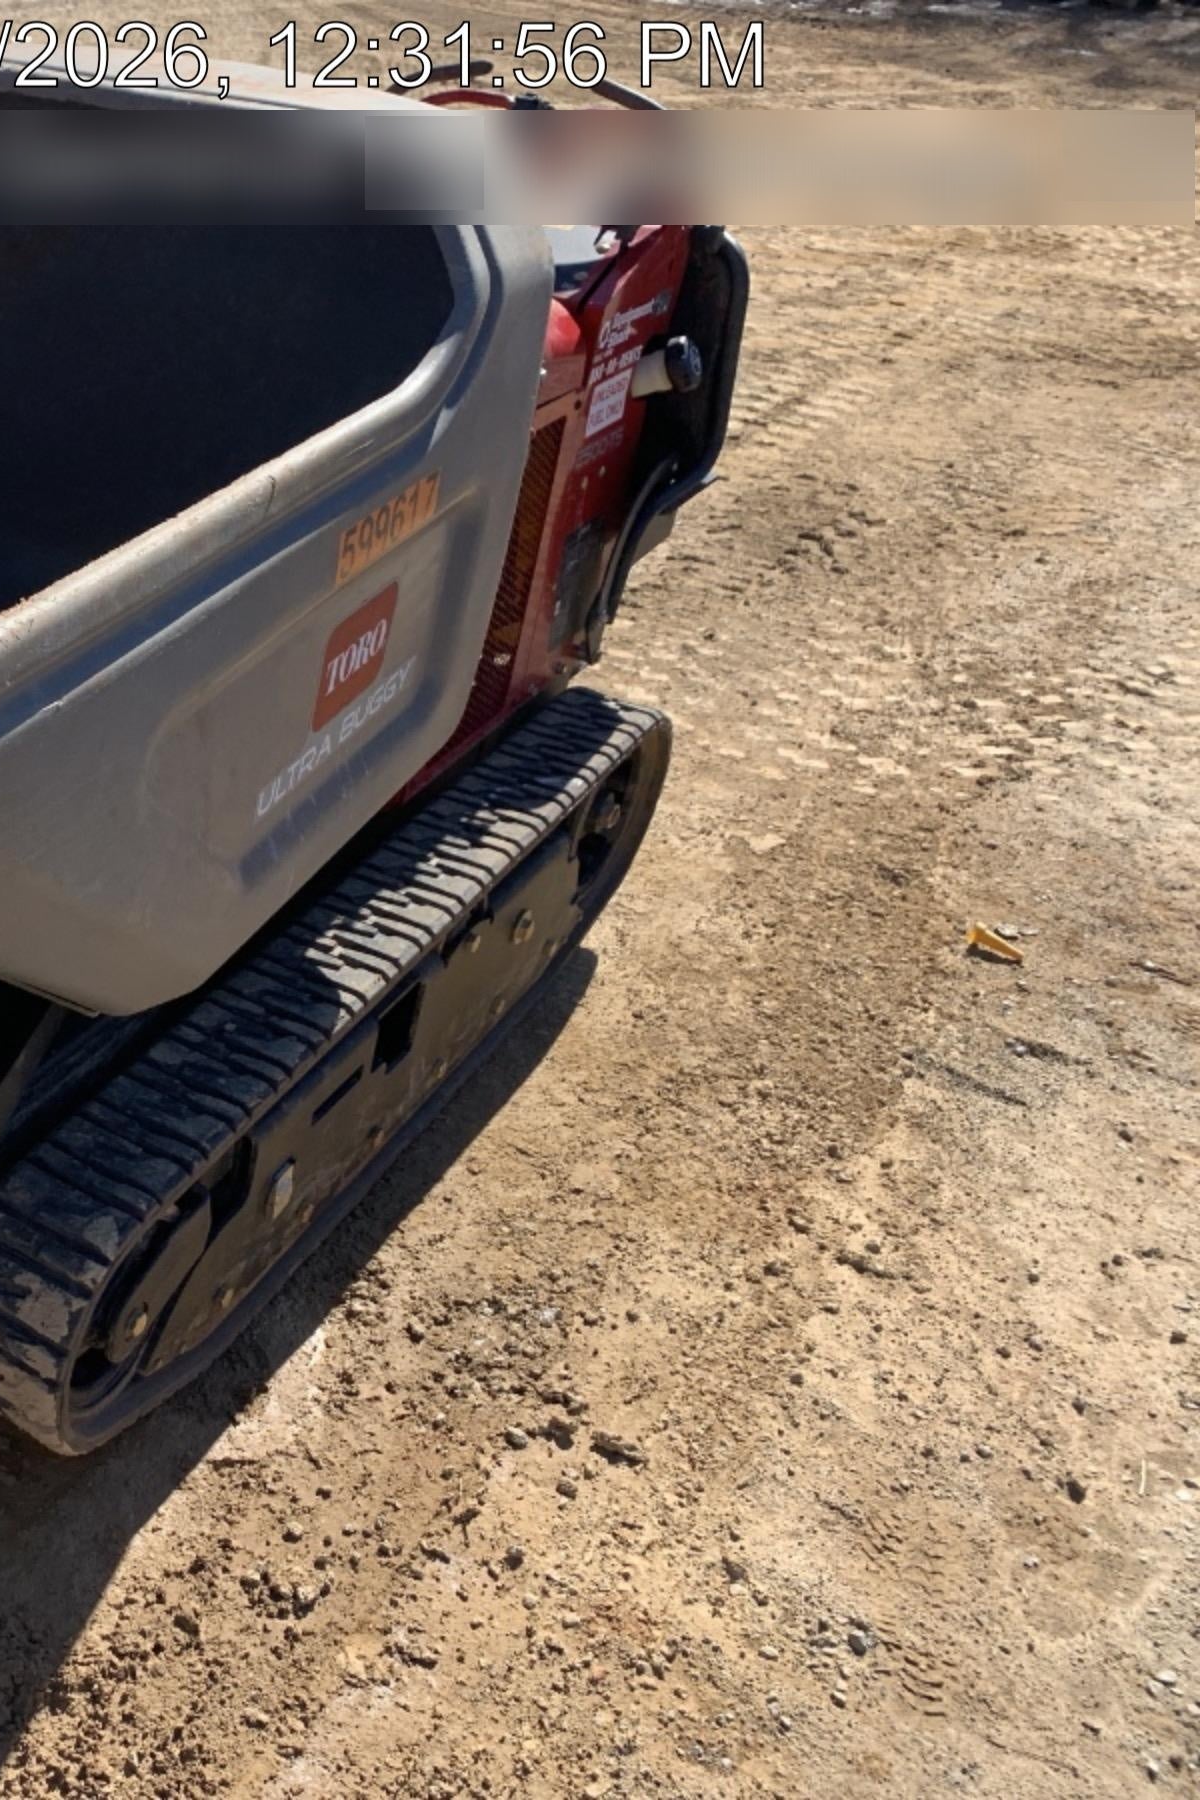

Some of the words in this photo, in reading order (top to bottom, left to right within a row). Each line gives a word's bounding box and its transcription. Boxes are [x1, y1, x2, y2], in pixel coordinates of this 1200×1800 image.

[325, 618, 387, 696] TORO
[256, 733, 332, 817] ULTRA
[338, 655, 417, 743] BUGGY
